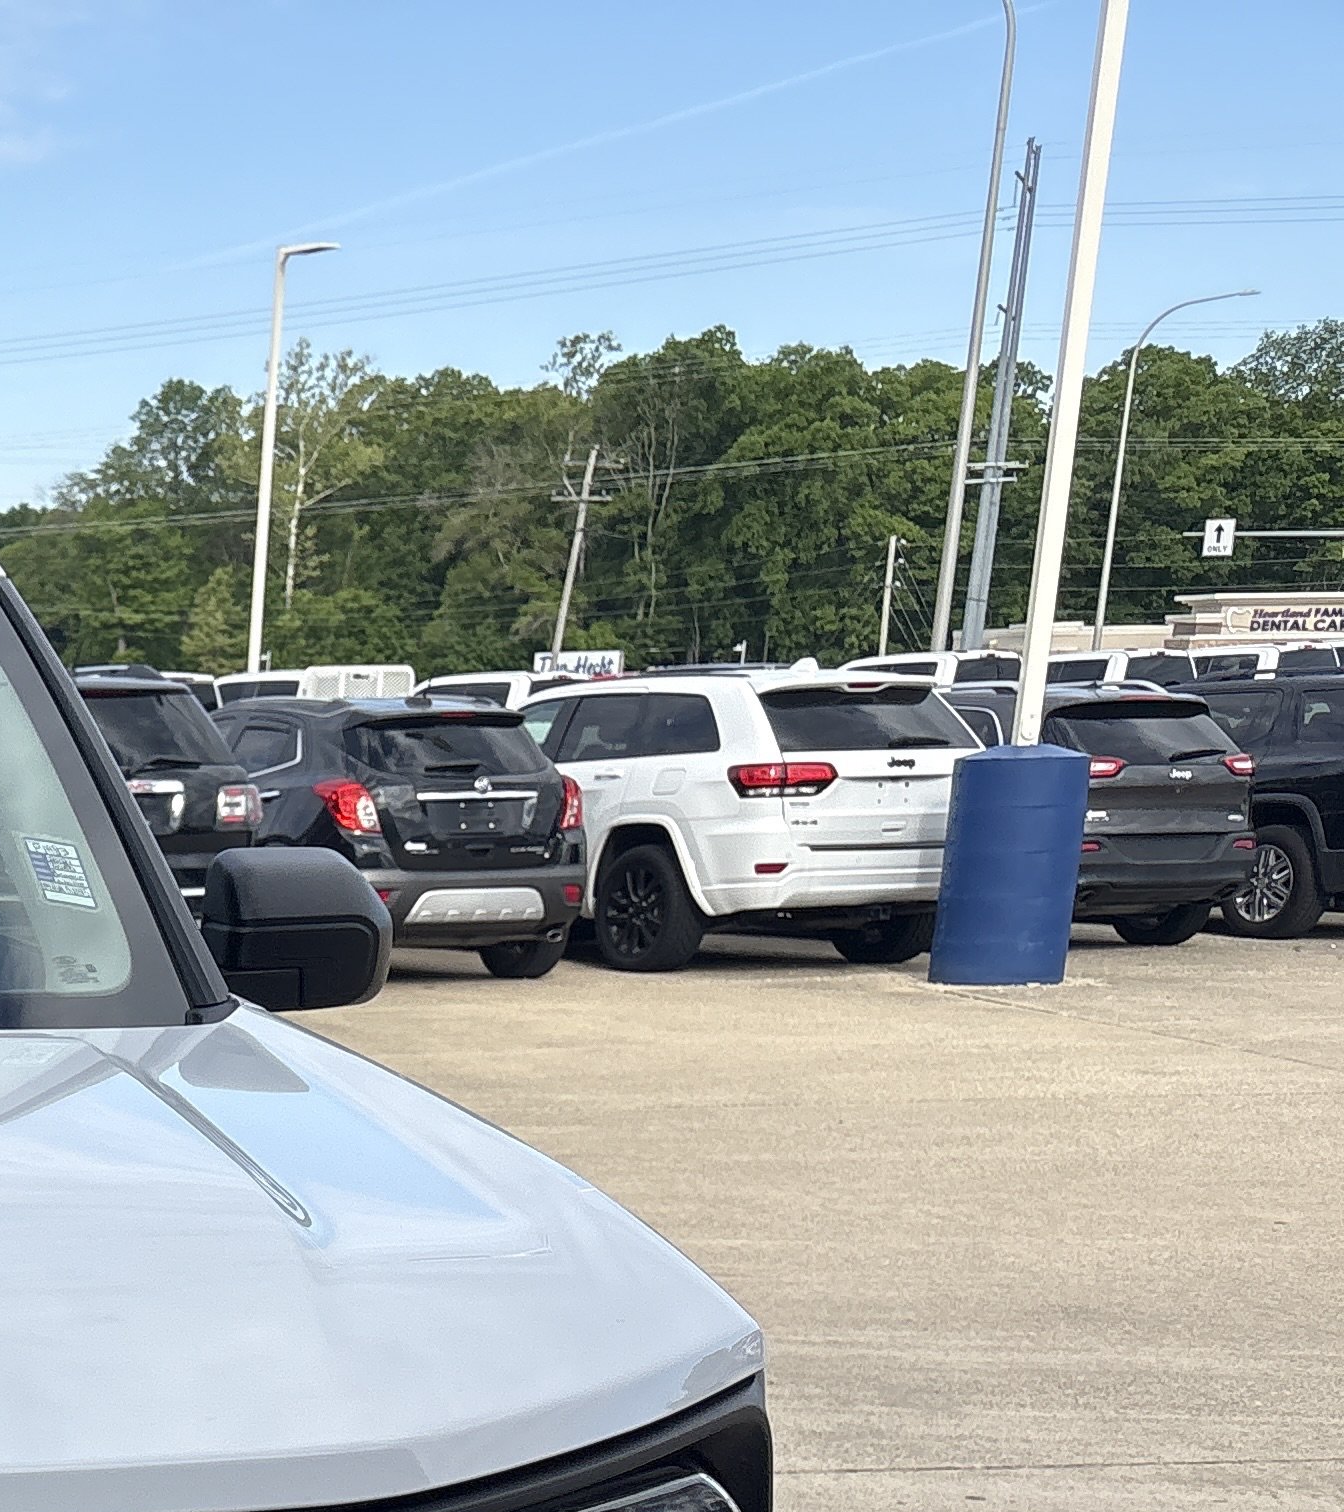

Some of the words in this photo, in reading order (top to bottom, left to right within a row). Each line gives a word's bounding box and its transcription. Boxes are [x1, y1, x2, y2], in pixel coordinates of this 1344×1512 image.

[1207, 545, 1228, 553] ONLY
[1249, 619, 1309, 632] DENTAL
[886, 756, 916, 769] Jeep
[1168, 768, 1193, 780] Jeep
